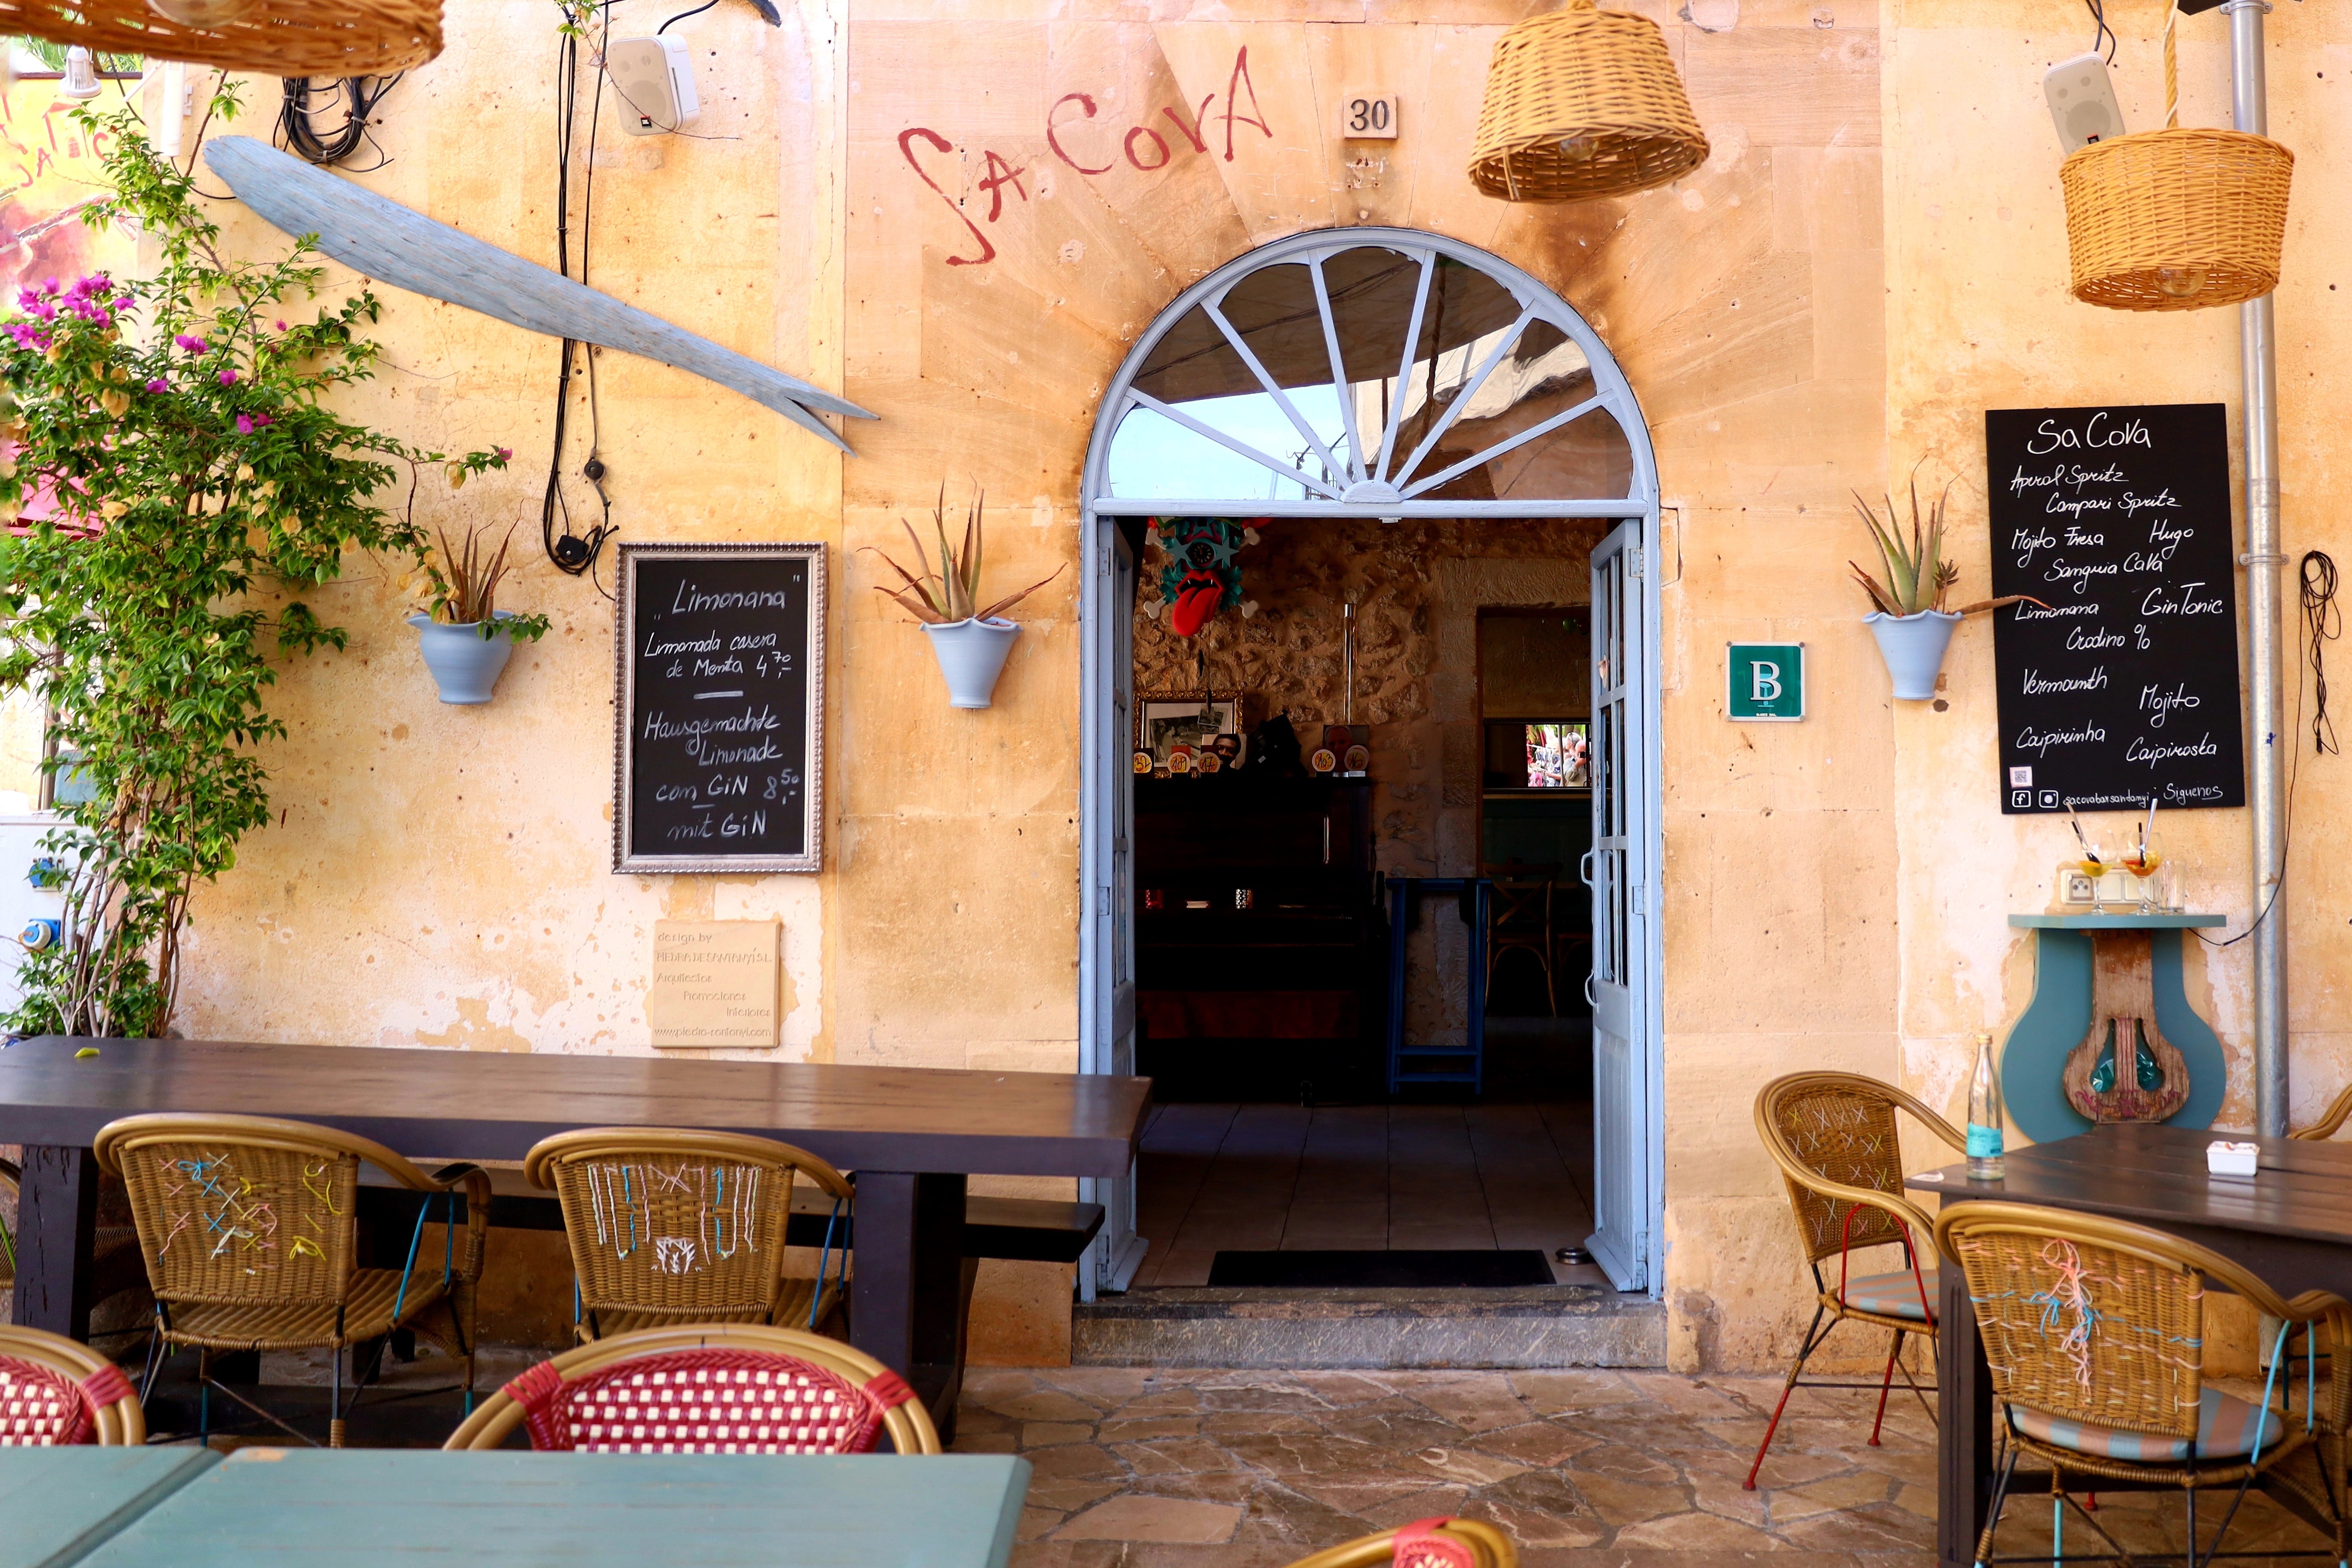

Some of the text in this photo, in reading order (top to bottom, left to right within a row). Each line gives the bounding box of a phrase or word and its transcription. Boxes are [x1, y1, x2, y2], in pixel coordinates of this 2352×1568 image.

[1350, 99, 1390, 130] 30
[898, 127, 1028, 266] SA
[2027, 419, 2081, 454] Sa
[2009, 462, 2129, 498] Aperol Spritz
[2046, 488, 2182, 519] Campari Spritz
[2011, 526, 2104, 568] Mojito Fresa
[2149, 519, 2194, 560] Hugo
[2015, 600, 2099, 621] Limonana
[644, 629, 776, 657] Limonada casera
[2066, 626, 2126, 650] Crodino
[666, 659, 683, 678] de
[693, 655, 743, 677] Menta
[1750, 661, 1782, 700] B
[2139, 683, 2200, 728] Mojito
[644, 704, 781, 755] Hausgemachte
[2016, 719, 2105, 759] Caipirinha
[698, 735, 783, 766] Limonade
[1135, 755, 1151, 771] 32
[1171, 756, 1187, 771] 109
[1200, 756, 1216, 772] 17
[656, 785, 697, 801] con
[667, 813, 712, 840] mit
[658, 933, 712, 945] design by
[656, 952, 691, 962] PIEDRA
[656, 973, 712, 985] Arquitectos
[684, 991, 747, 1001] Promociones
[726, 1008, 771, 1017] Interiores
